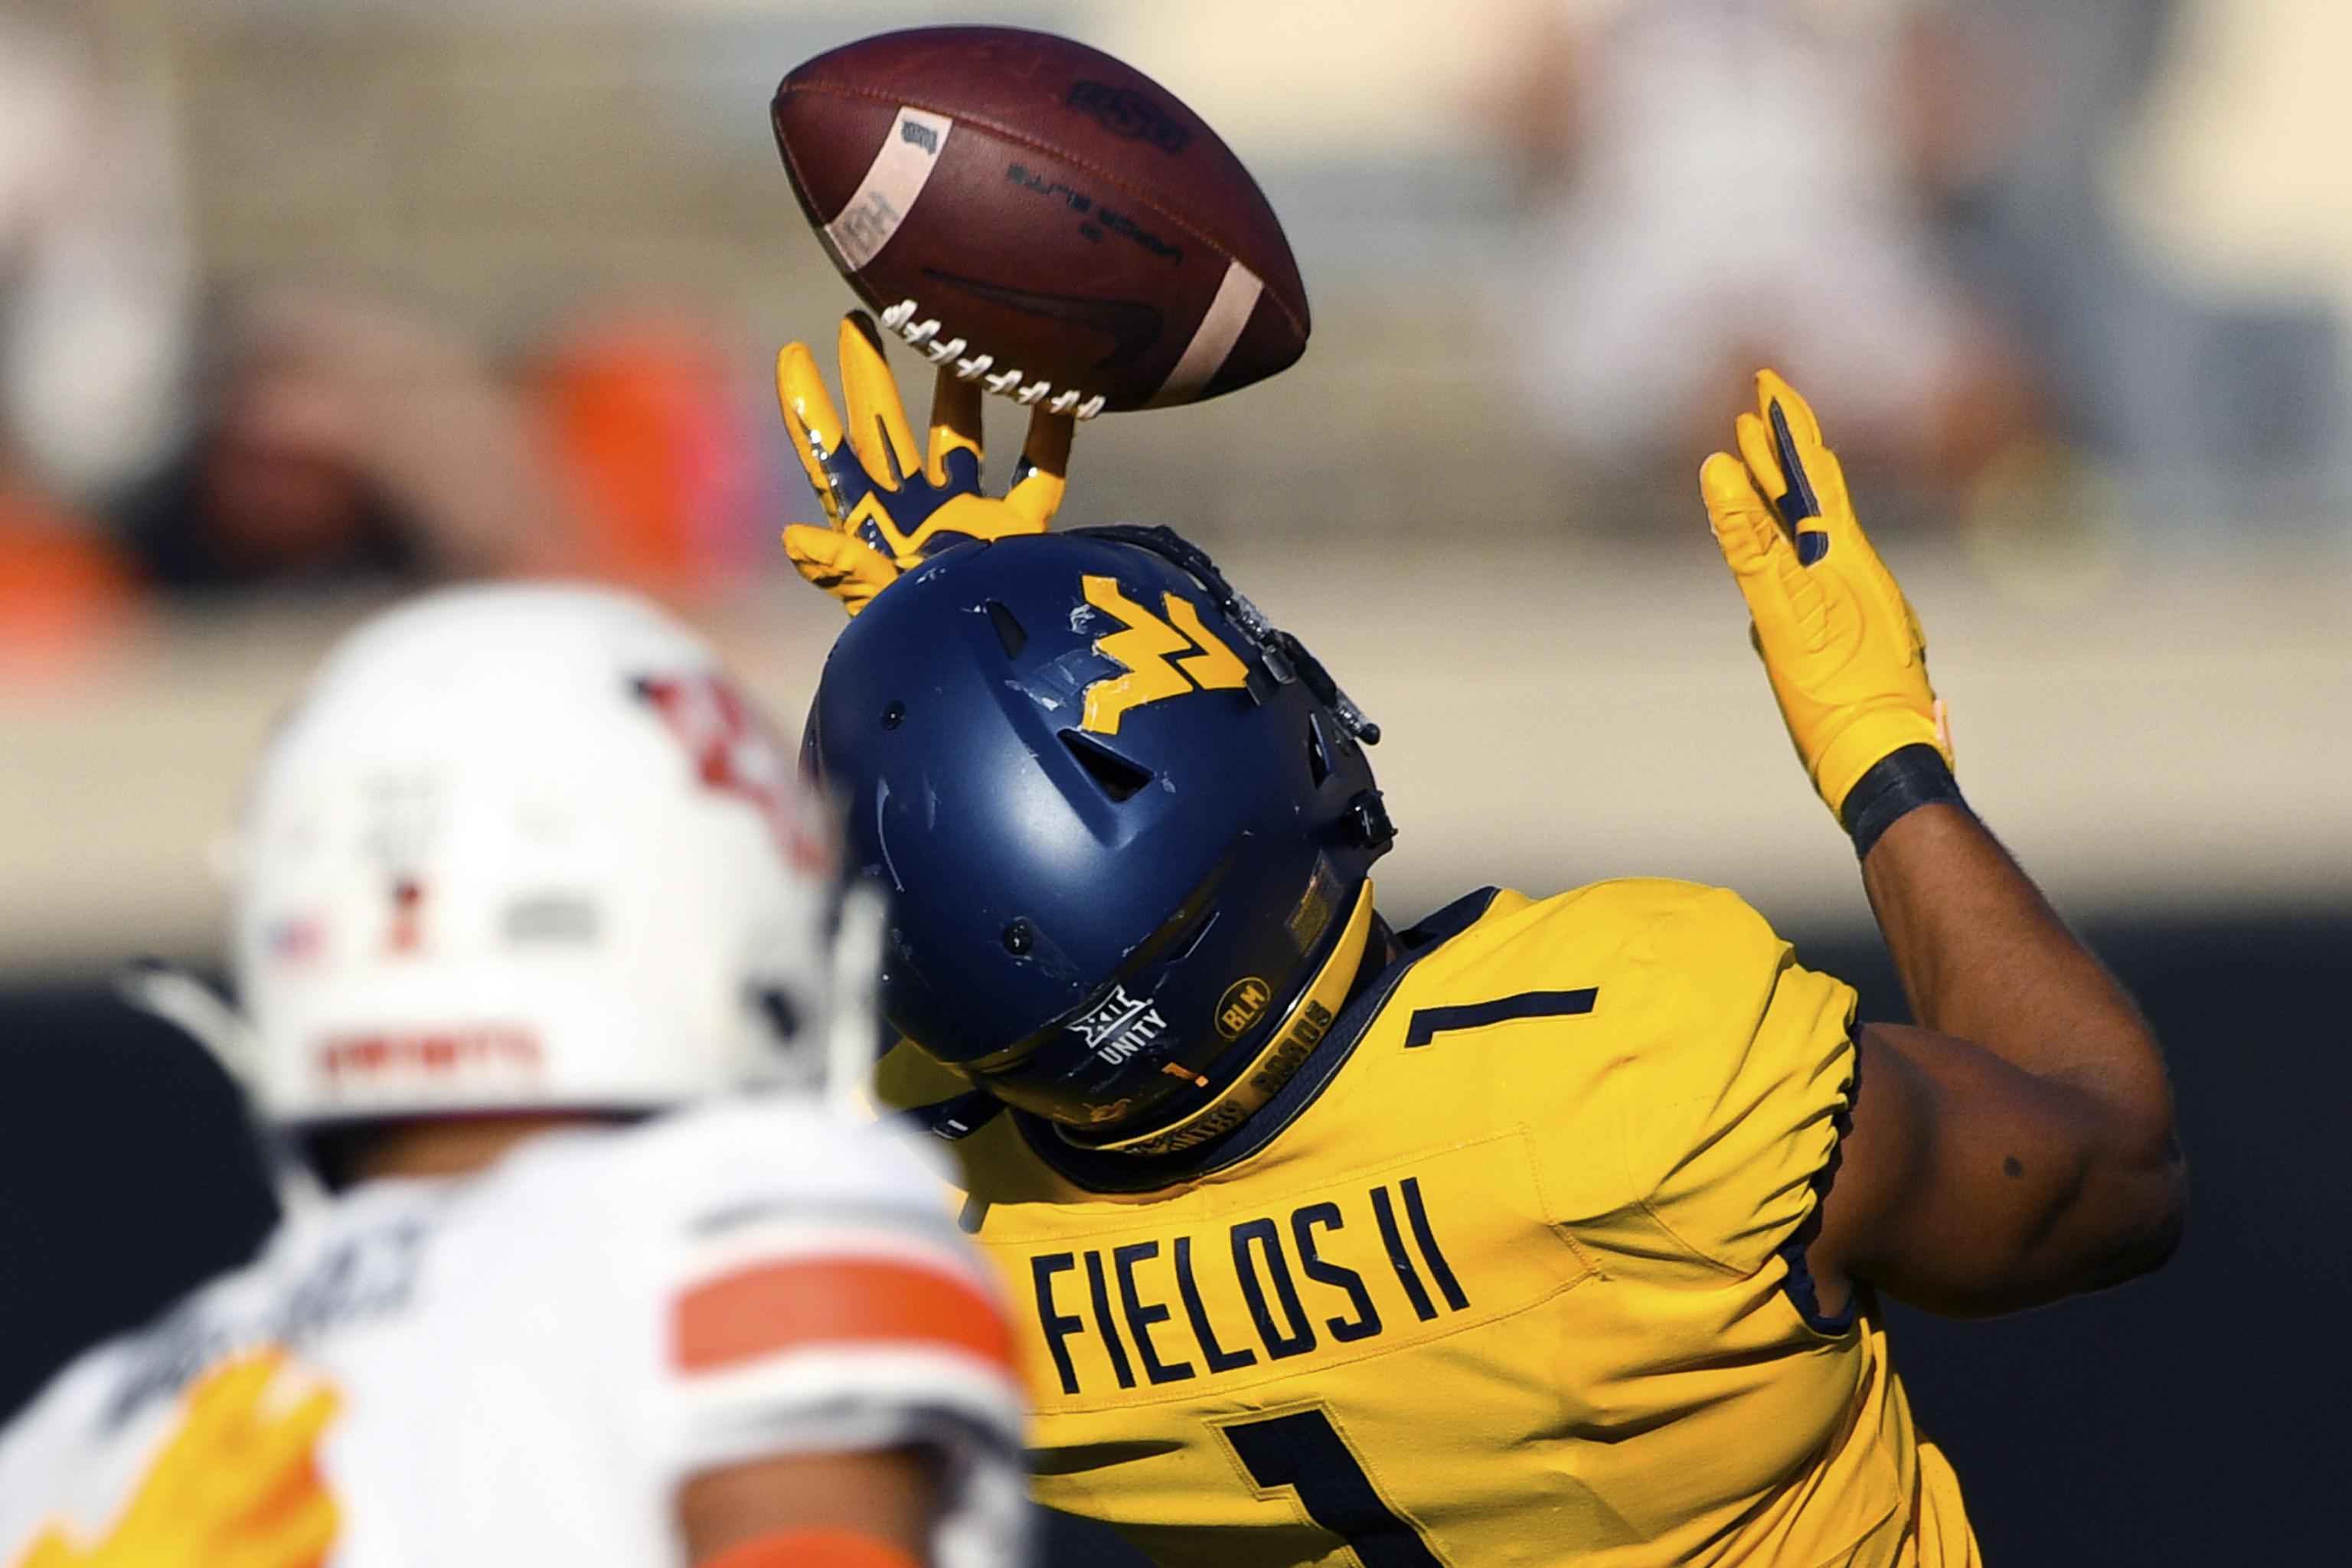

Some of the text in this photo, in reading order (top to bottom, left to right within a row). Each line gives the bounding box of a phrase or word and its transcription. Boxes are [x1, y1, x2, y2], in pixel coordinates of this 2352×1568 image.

[1097, 1008, 1168, 1066] UNITY
[1221, 984, 1266, 1032] BLM
[1404, 986, 1599, 1049] 1
[1031, 1176, 1471, 1395] FIELDS II
